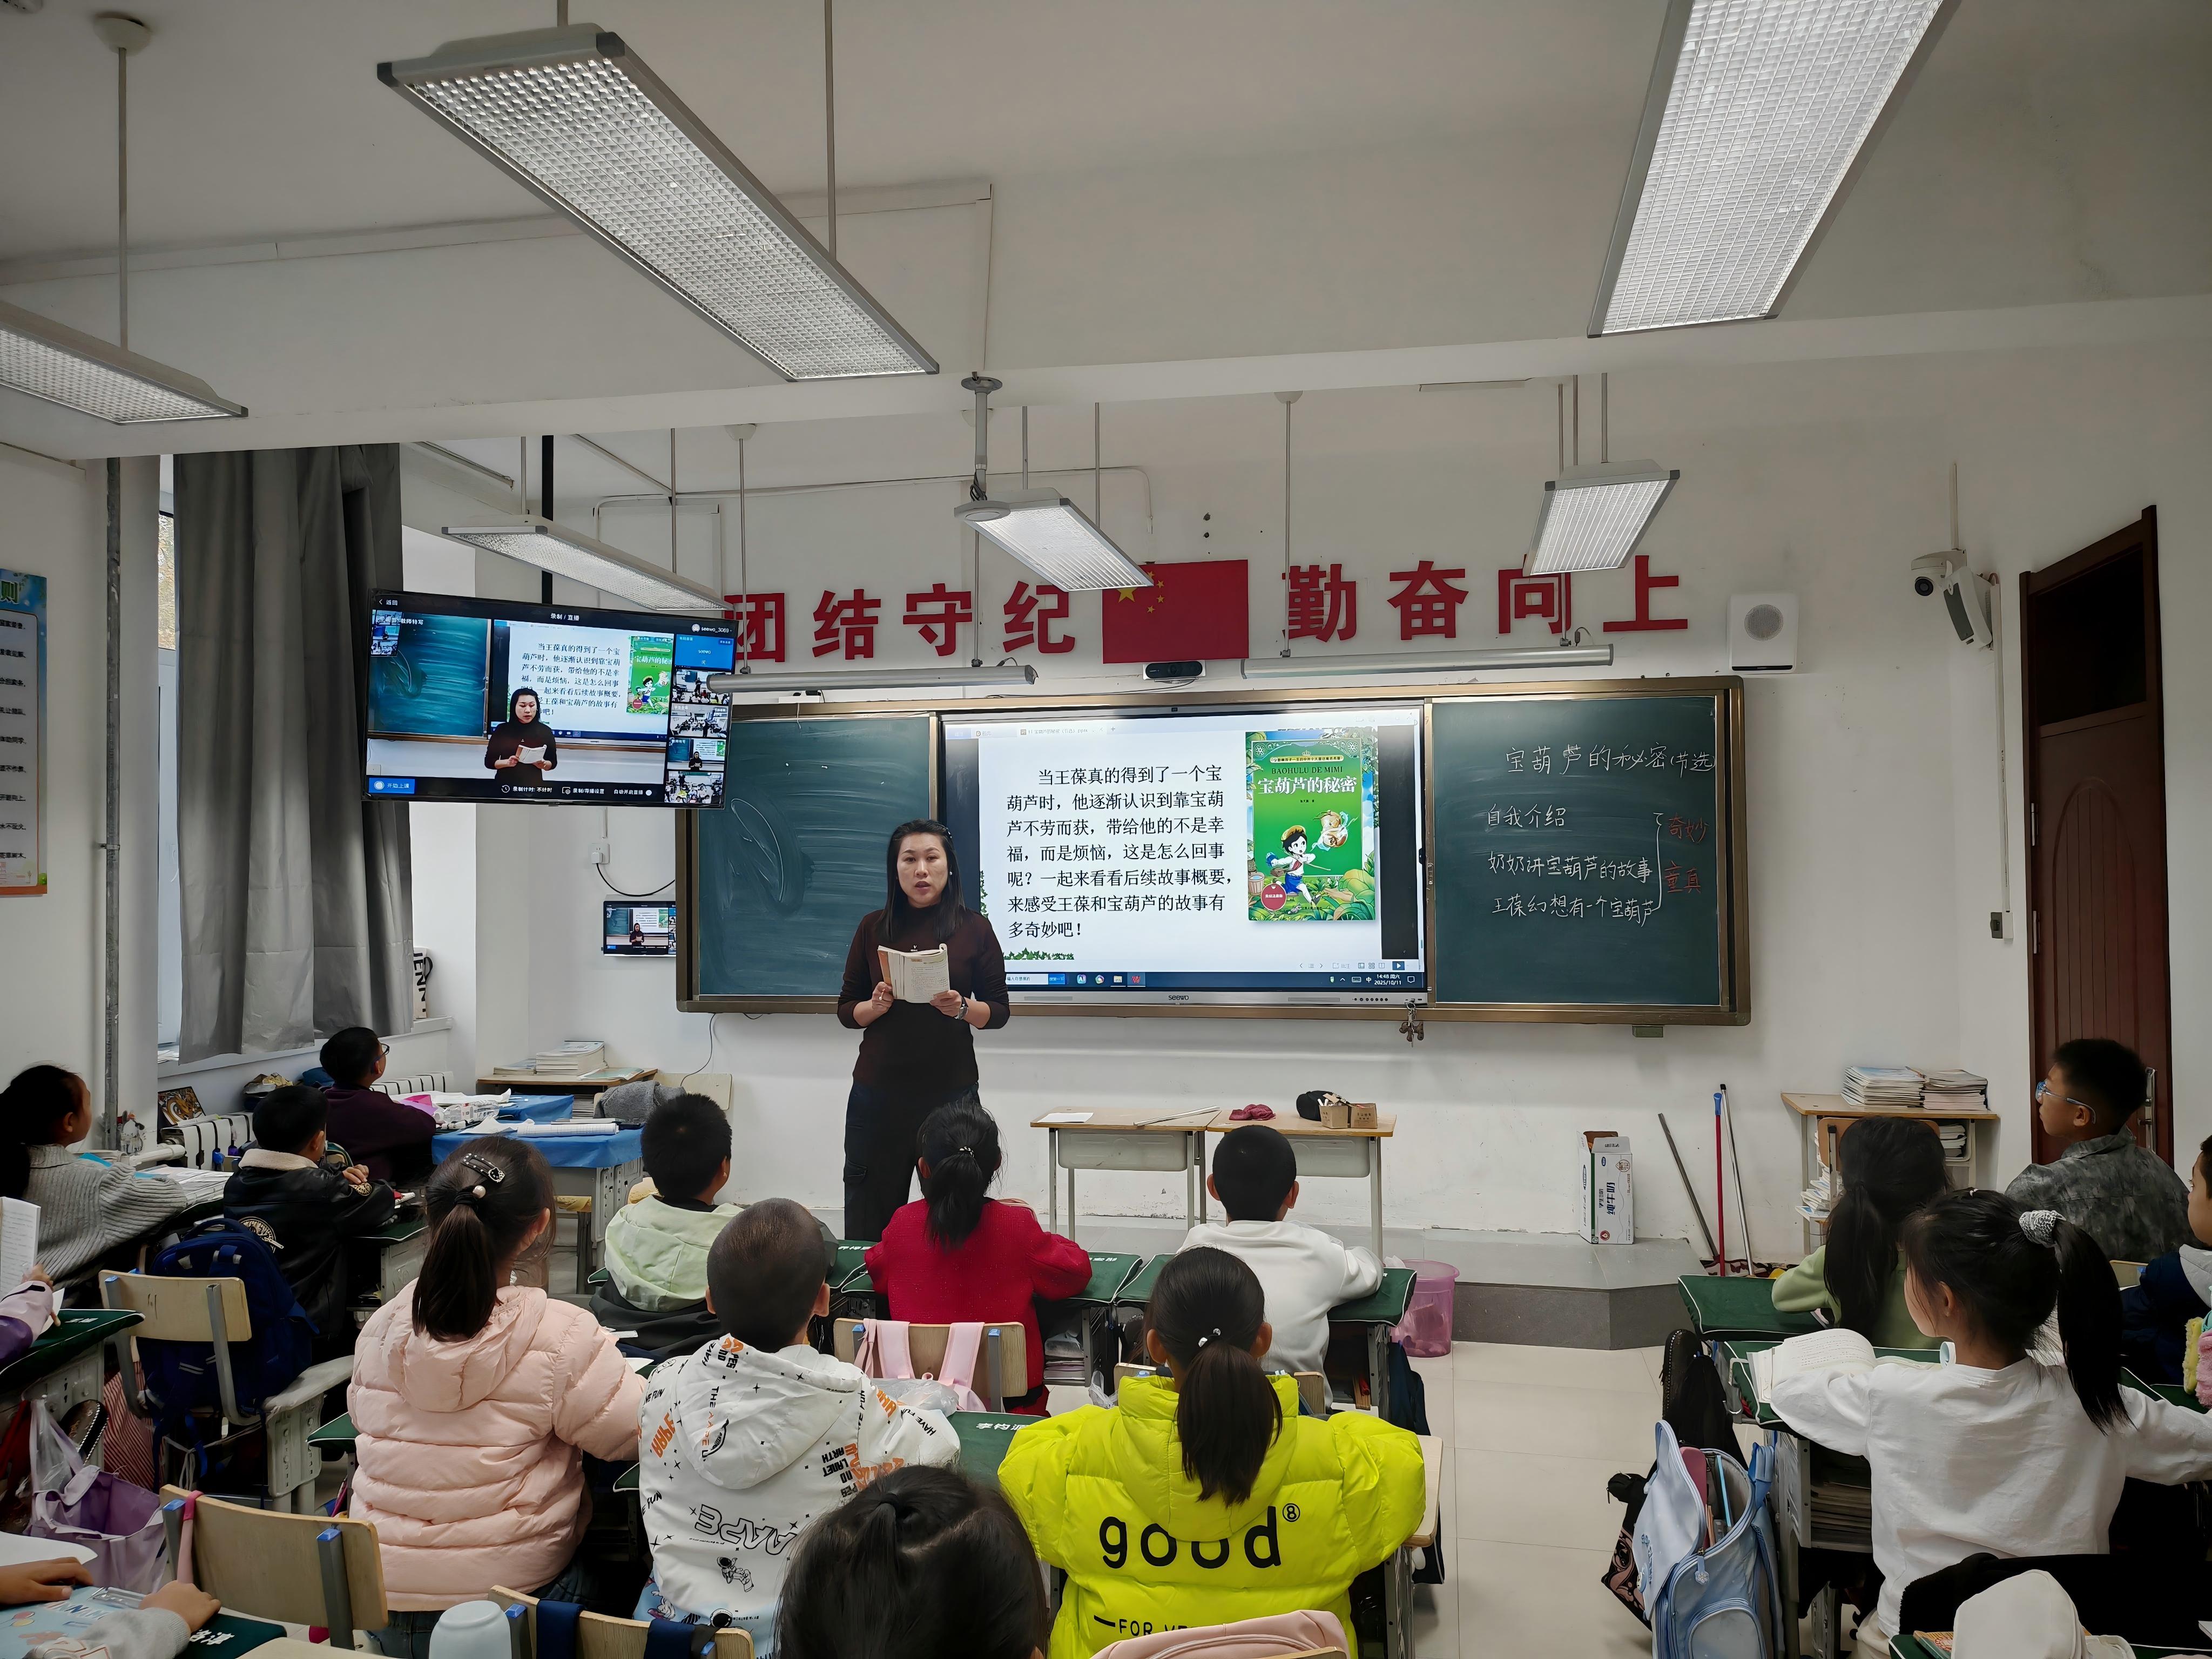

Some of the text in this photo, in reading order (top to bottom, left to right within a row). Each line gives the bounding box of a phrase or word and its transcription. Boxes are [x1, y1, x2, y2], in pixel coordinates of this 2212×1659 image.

[1282, 555, 1688, 643] 勤奋向上
[1038, 764, 1222, 786] 当王葆真的得到了一个宝
[1257, 775, 1357, 794] 宝葫芦的秘密
[1007, 790, 1223, 812] 葫芦时，他逐渐认识到靠宝葫
[1487, 802, 1566, 828] 自我介绍
[1007, 816, 1224, 837] 芦不劳而获，带给他的不是幸
[1668, 812, 1710, 842] 奇妙
[1007, 842, 1225, 862] 福，而是烦恼，这是怎么回事
[1008, 868, 1231, 887] 呢？一起来看看后续故事概要，
[1487, 851, 1653, 884] 奶奶讲宝葫芦的故事
[1664, 860, 1702, 894] 童真
[1007, 894, 1225, 913] 来感受王葆和宝葫芦的故事有
[1491, 893, 1654, 927] 王葆幻想有一个宝葫芦
[1008, 921, 1081, 939] 多奇妙吧！
[915, 1416, 937, 1437] HAVE
[694, 1504, 798, 1555] AAPE
